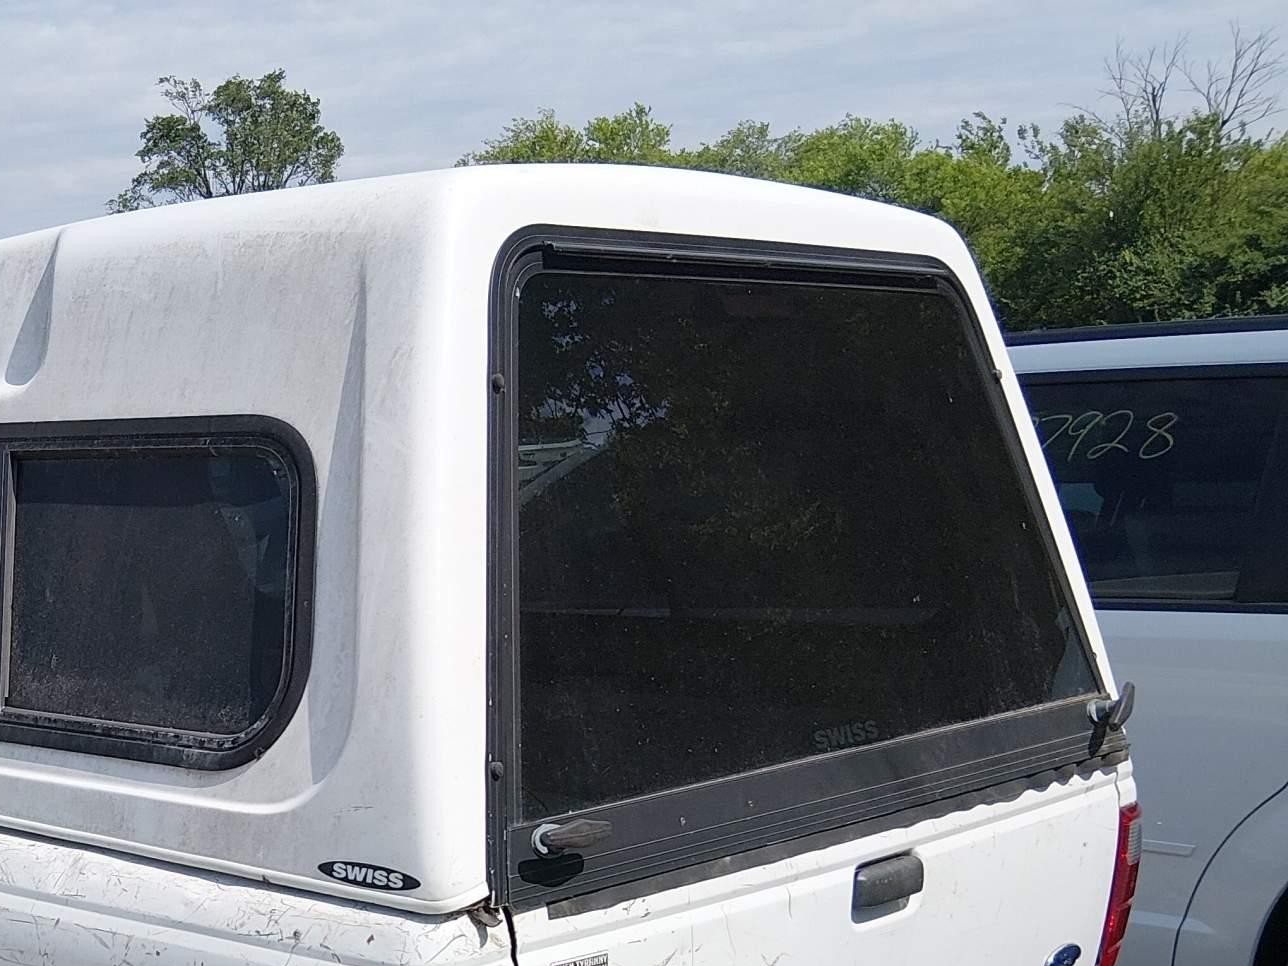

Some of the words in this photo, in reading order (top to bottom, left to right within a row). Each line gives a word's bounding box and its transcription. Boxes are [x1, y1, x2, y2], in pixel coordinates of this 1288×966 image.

[1032, 409, 1179, 462] 7928
[813, 720, 879, 750] SWISS
[332, 862, 404, 889] SWISS
